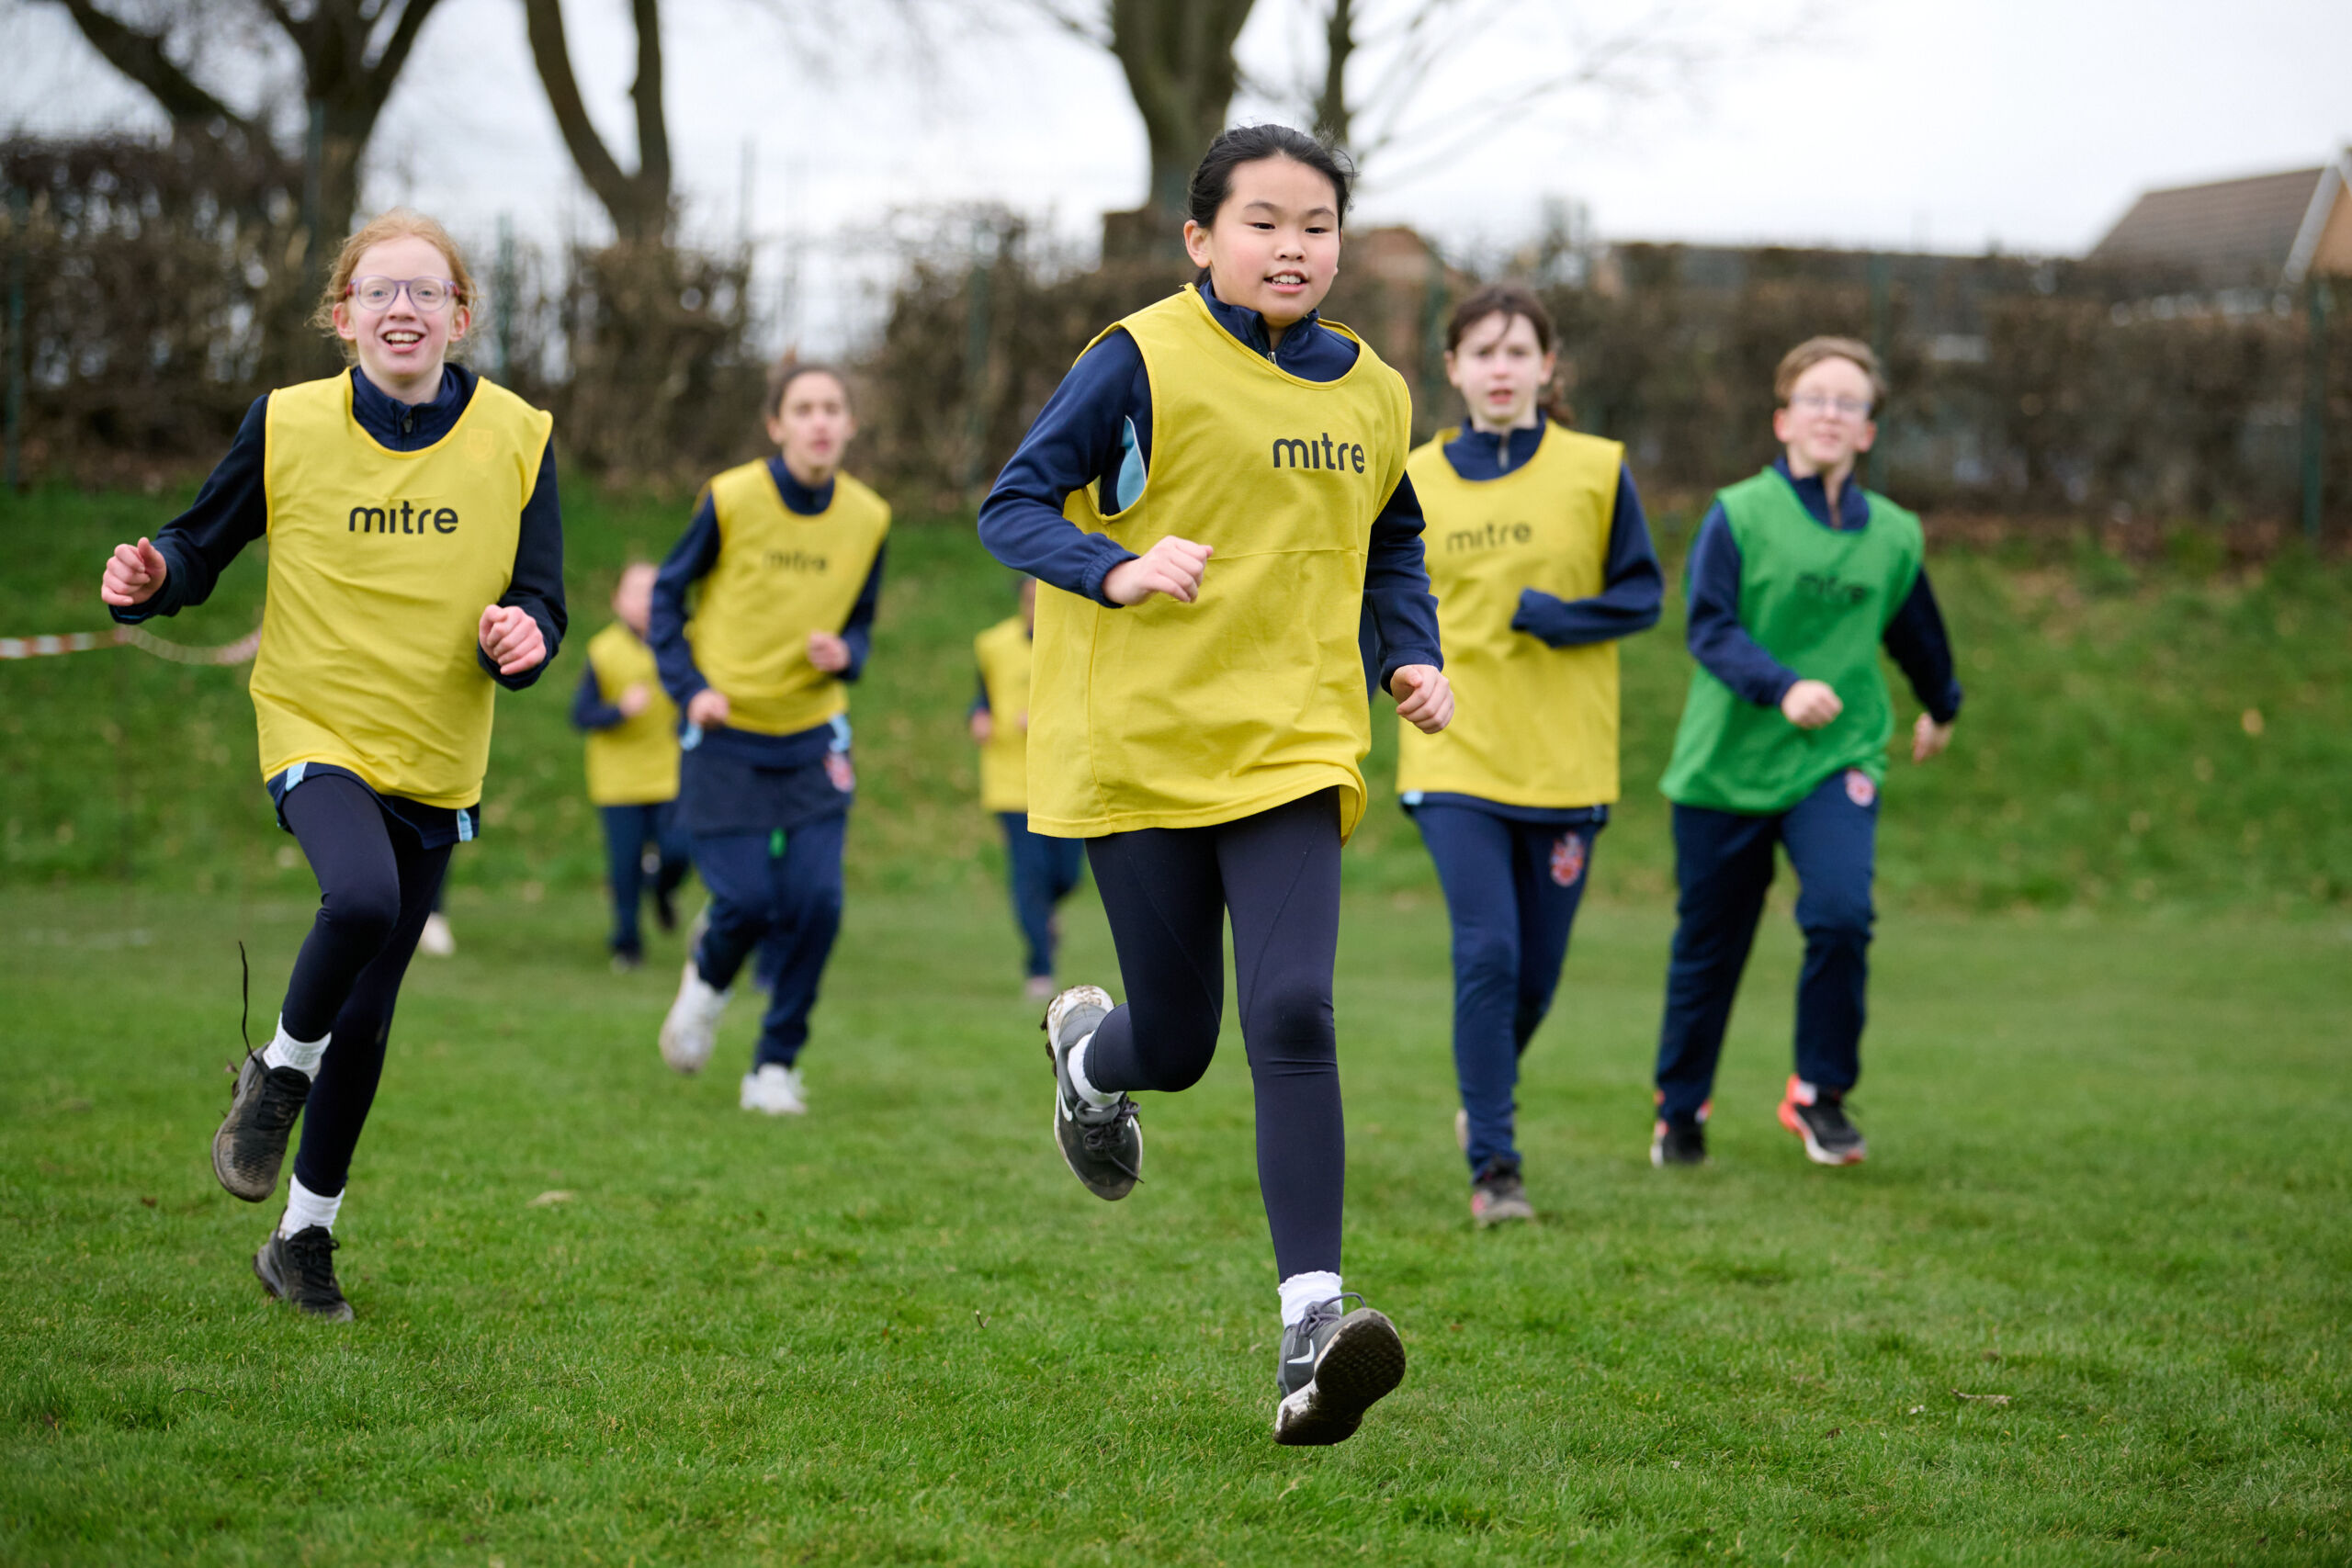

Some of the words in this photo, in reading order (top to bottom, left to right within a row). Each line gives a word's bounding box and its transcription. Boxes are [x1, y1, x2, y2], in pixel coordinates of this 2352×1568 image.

[1272, 432, 1365, 474] mitre
[349, 501, 458, 535] mitre
[1446, 521, 1532, 553] mitre
